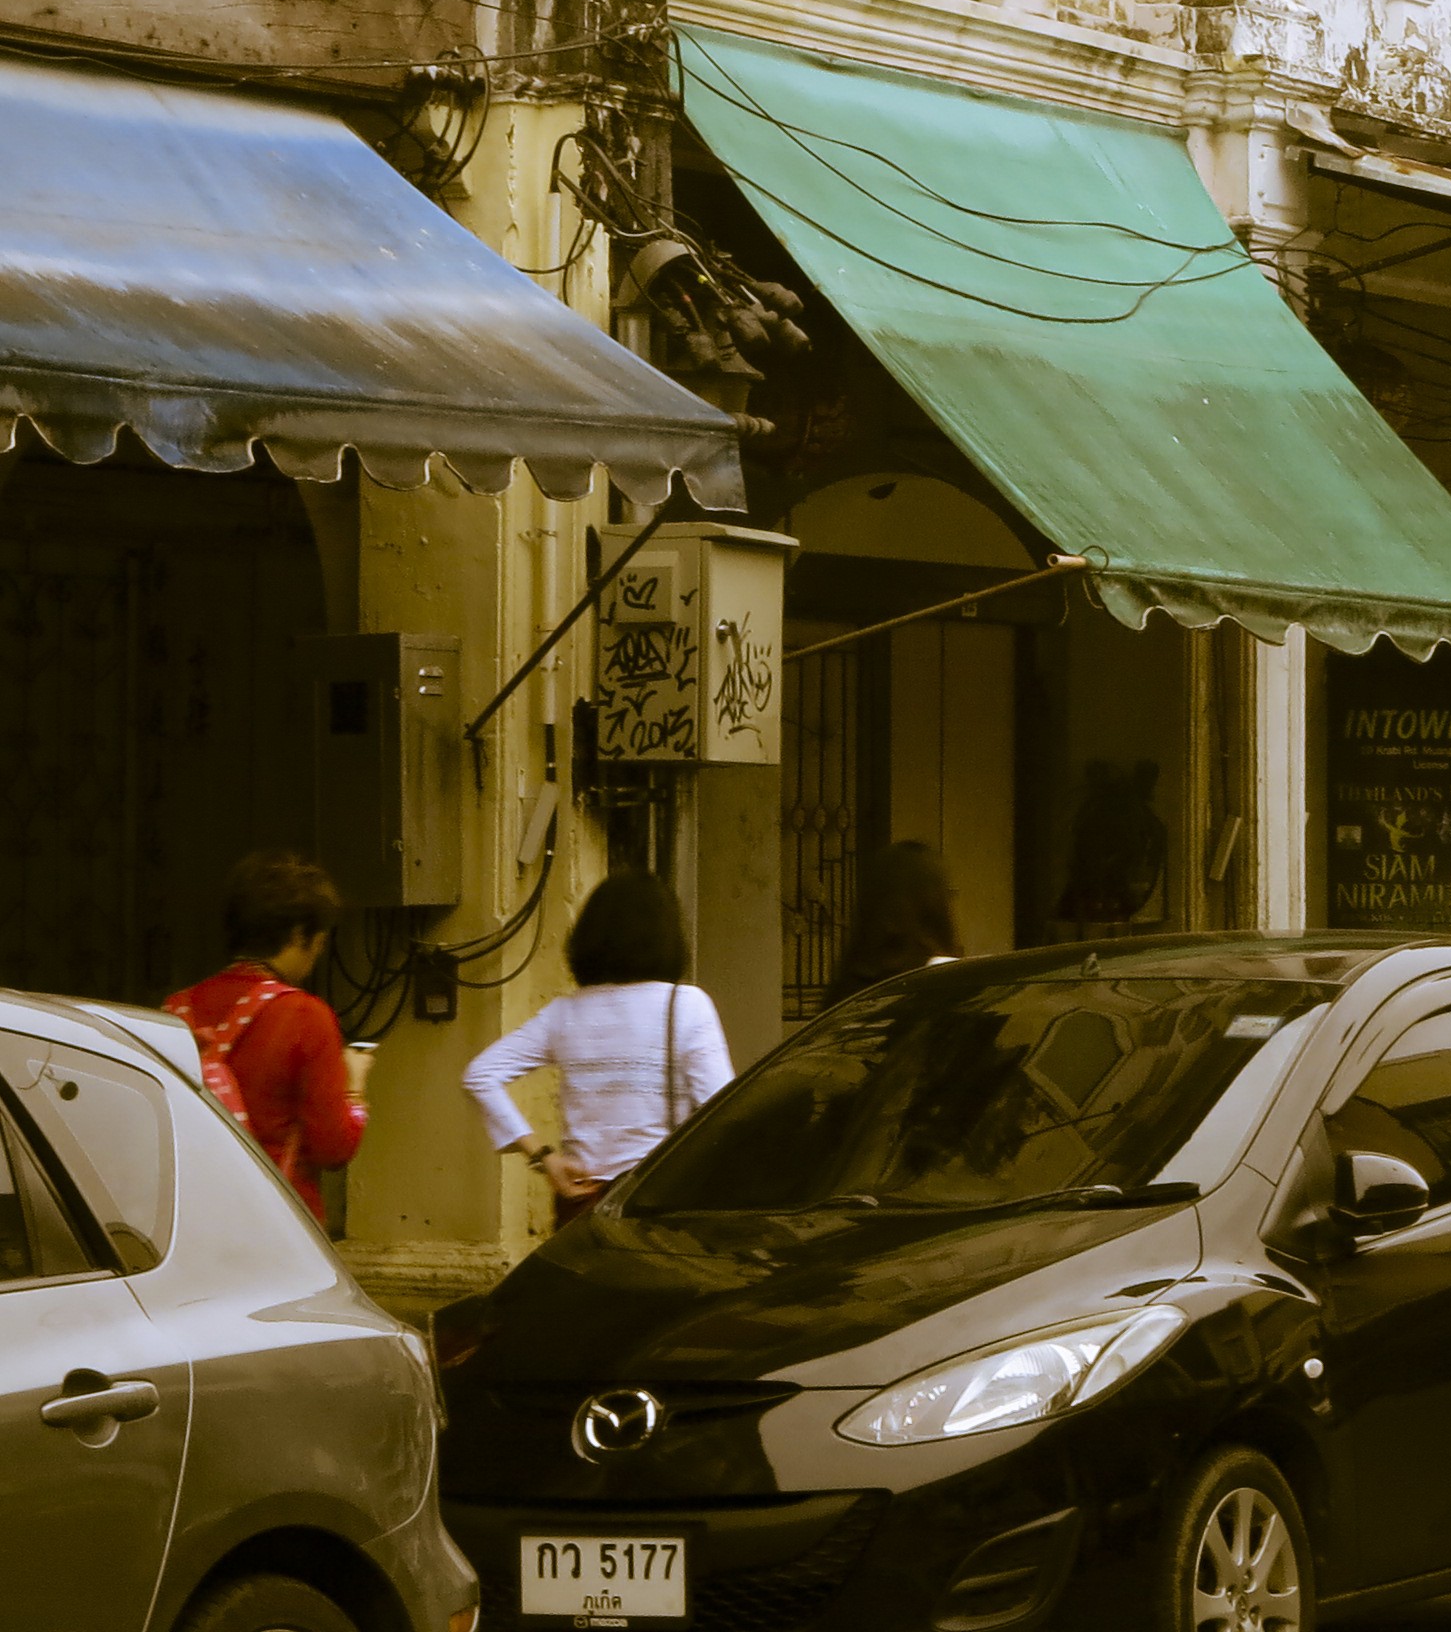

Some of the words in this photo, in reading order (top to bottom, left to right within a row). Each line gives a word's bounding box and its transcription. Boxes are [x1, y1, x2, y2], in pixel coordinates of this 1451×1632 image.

[1363, 853, 1437, 881] SIAM
[537, 1542, 582, 1579] กว
[601, 1543, 678, 1580] 5177
